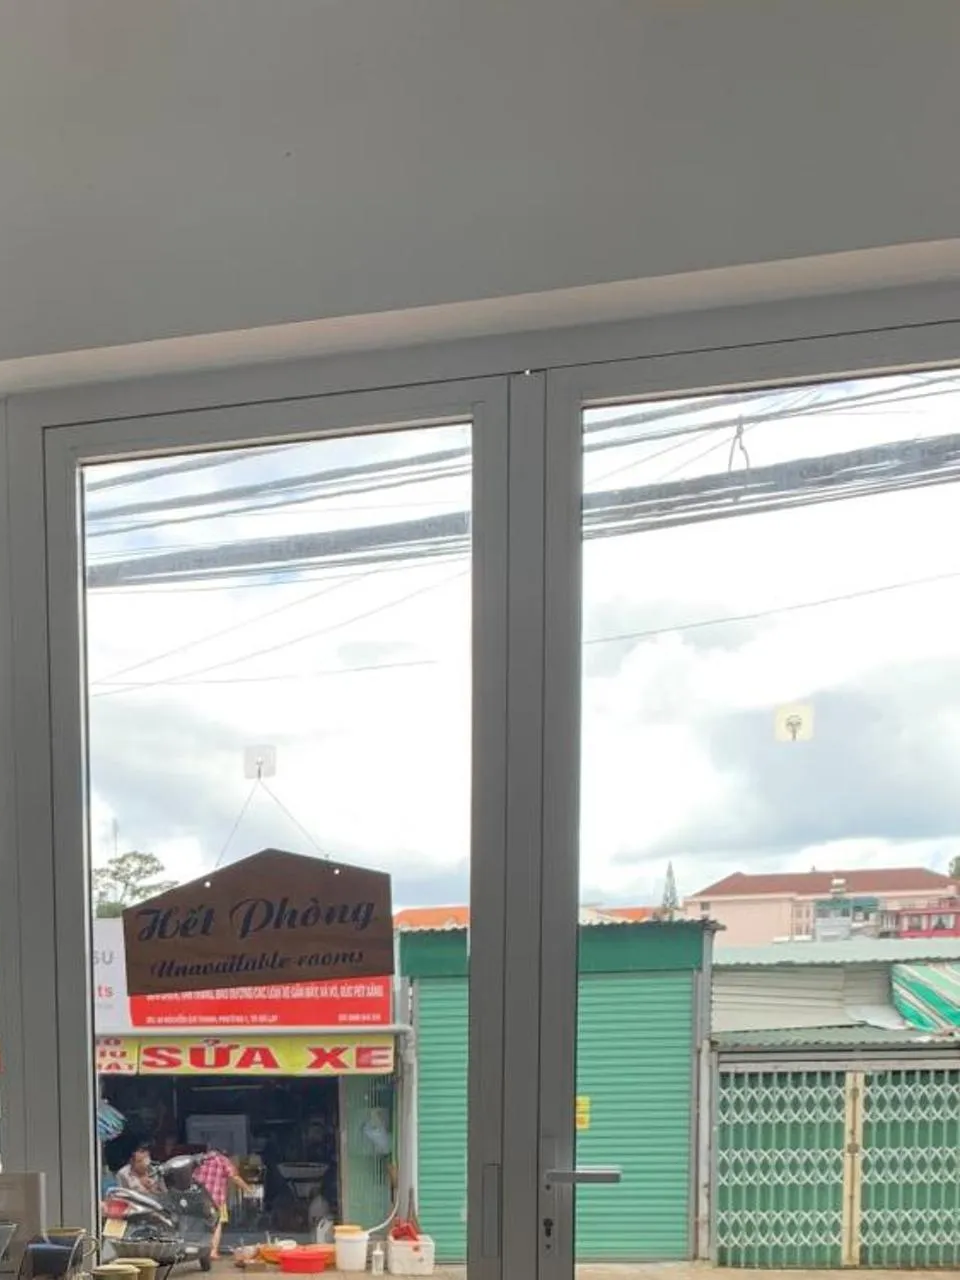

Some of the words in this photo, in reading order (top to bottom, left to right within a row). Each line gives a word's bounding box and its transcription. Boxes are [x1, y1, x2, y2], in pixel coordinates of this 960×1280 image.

[136, 904, 215, 941] Hết
[229, 897, 375, 939] Phòng
[150, 951, 291, 978] Unavailable
[141, 1037, 280, 1070] SỬA
[306, 1047, 393, 1070] XE
